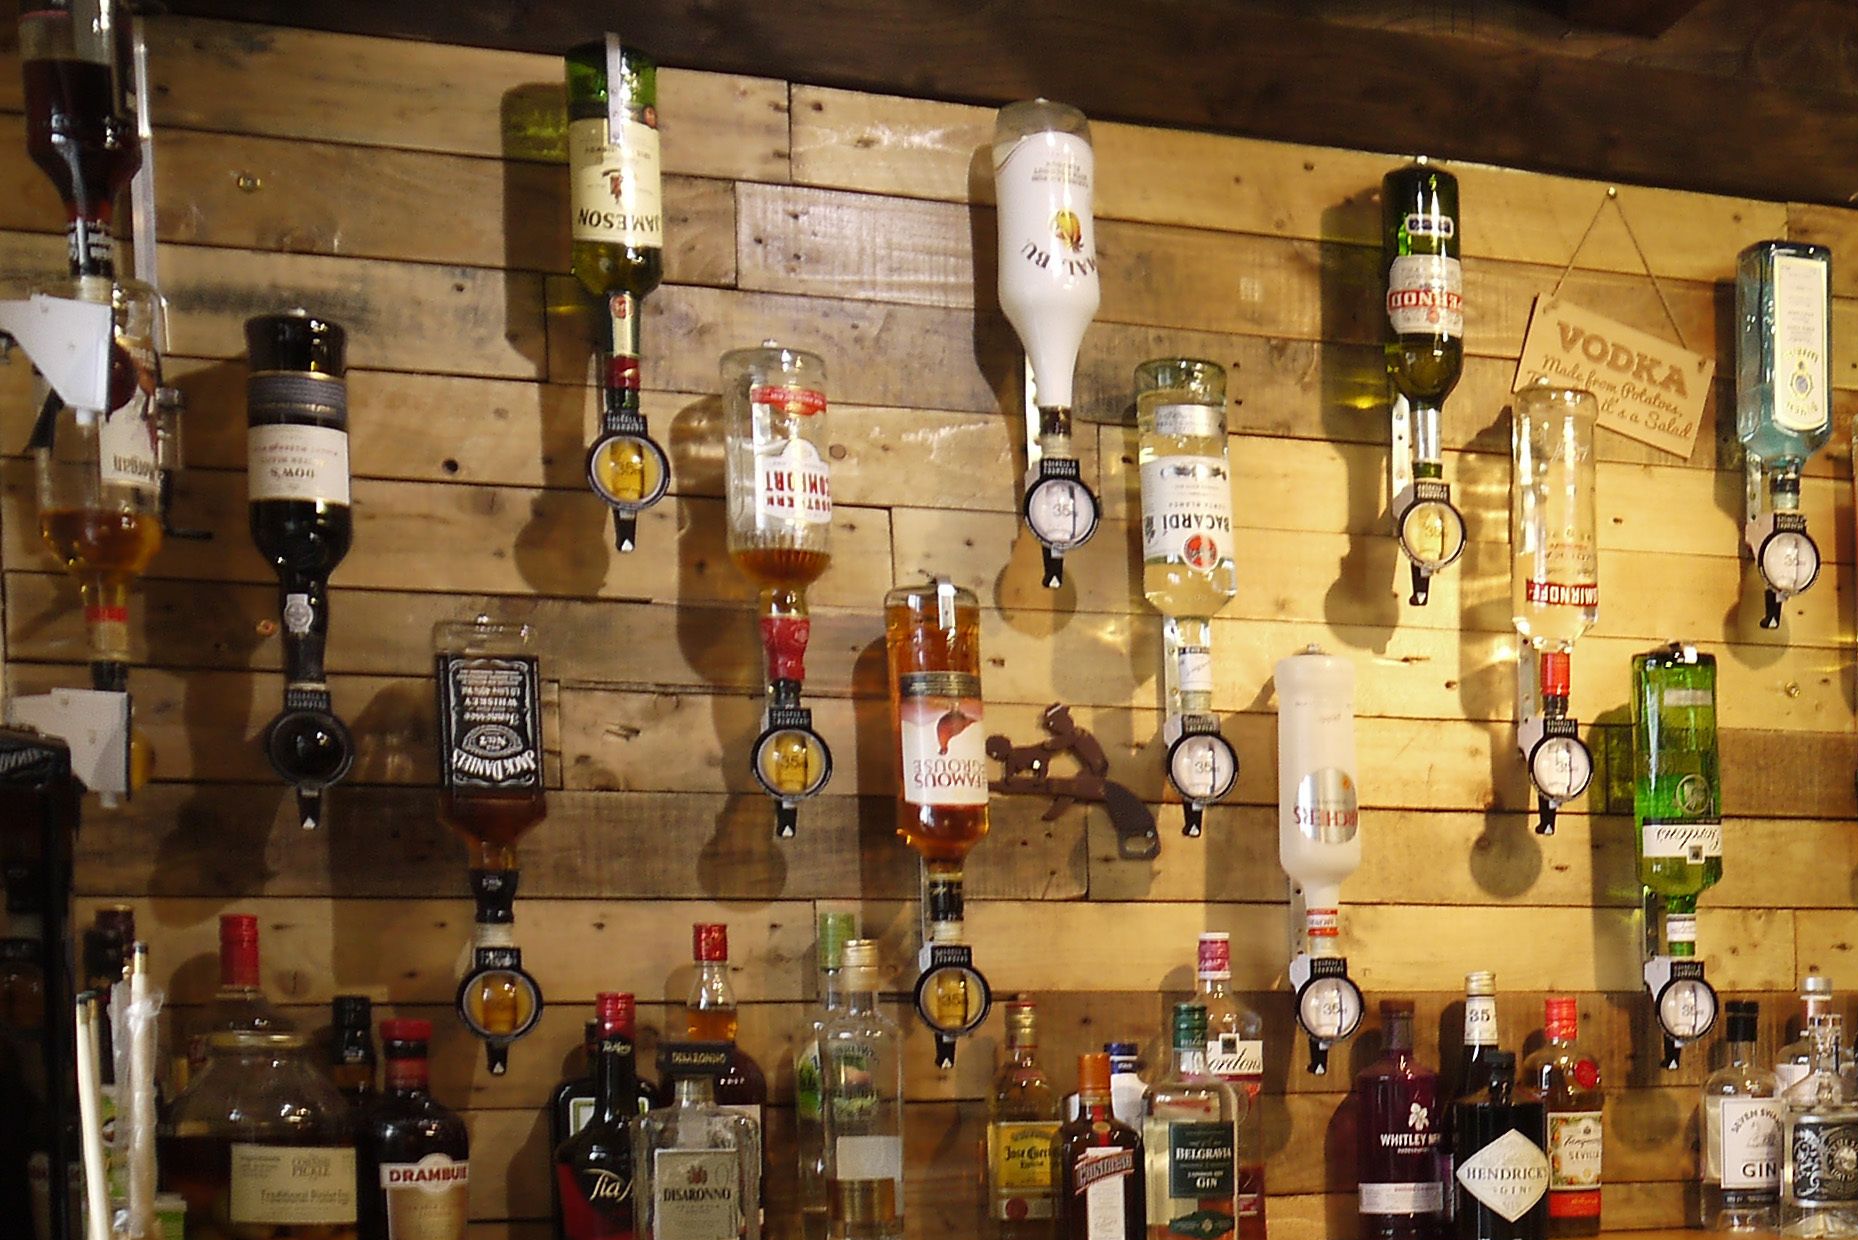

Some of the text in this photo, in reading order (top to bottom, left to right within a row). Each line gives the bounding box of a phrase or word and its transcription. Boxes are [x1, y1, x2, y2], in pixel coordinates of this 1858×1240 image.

[1021, 241, 1097, 278] MALBU
[1556, 319, 1688, 400] VODKA
[1542, 354, 1583, 381] Made
[1585, 369, 1619, 396] from
[1629, 412, 1640, 424] a
[1644, 411, 1694, 440] Salad
[504, 748, 537, 778] JACK
[1468, 1009, 1491, 1023] 35
[1380, 1132, 1428, 1149] WHITLEY
[1176, 1147, 1232, 1161] BELGRAVIA
[1741, 1160, 1778, 1179] GIN
[1196, 1176, 1220, 1189] GIN
[663, 1188, 732, 1203] DISARONNO
